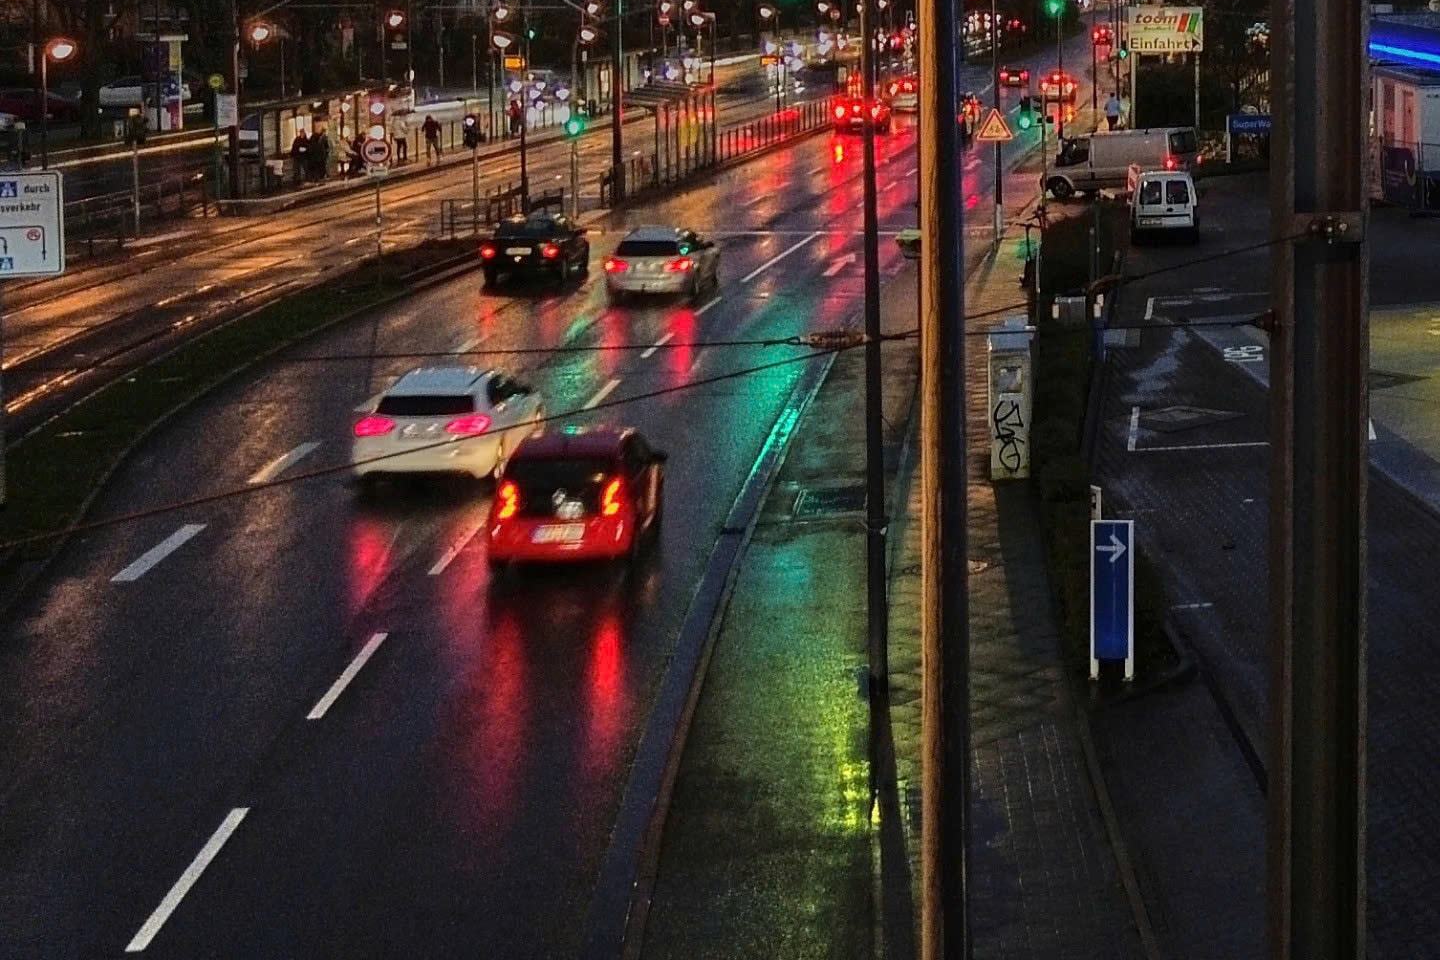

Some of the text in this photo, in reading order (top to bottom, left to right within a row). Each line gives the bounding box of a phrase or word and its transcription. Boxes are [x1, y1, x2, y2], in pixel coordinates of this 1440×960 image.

[1135, 14, 1178, 24] toom
[1130, 38, 1190, 50] Einfahrt
[24, 183, 50, 194] durch
